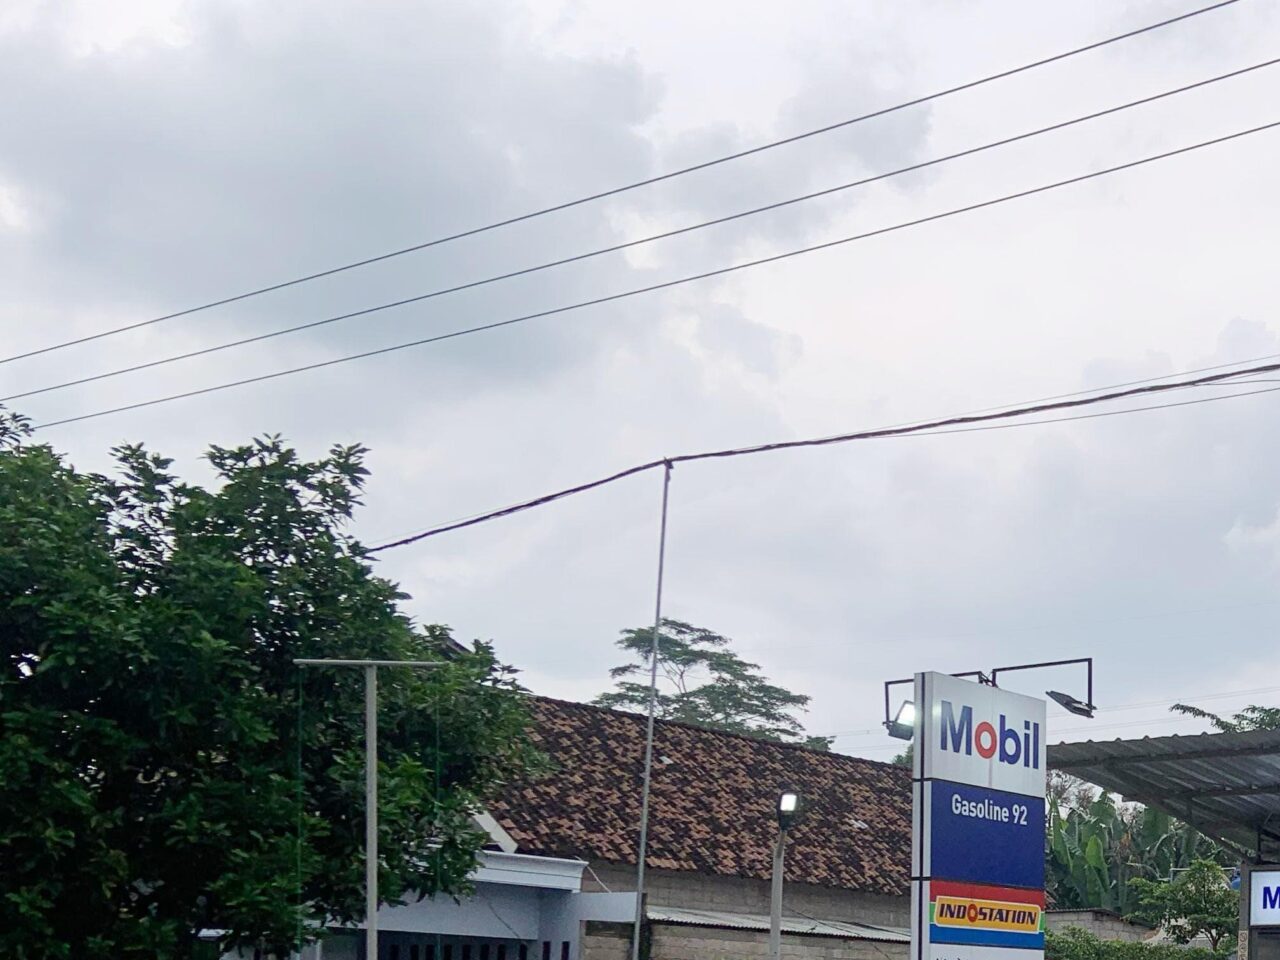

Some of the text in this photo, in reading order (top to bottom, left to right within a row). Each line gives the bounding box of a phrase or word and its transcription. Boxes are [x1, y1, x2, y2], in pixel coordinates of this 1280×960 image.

[940, 700, 1040, 770] Mobil
[952, 793, 1028, 826] Gasoline 92
[938, 903, 1038, 926] INDOSTATION
